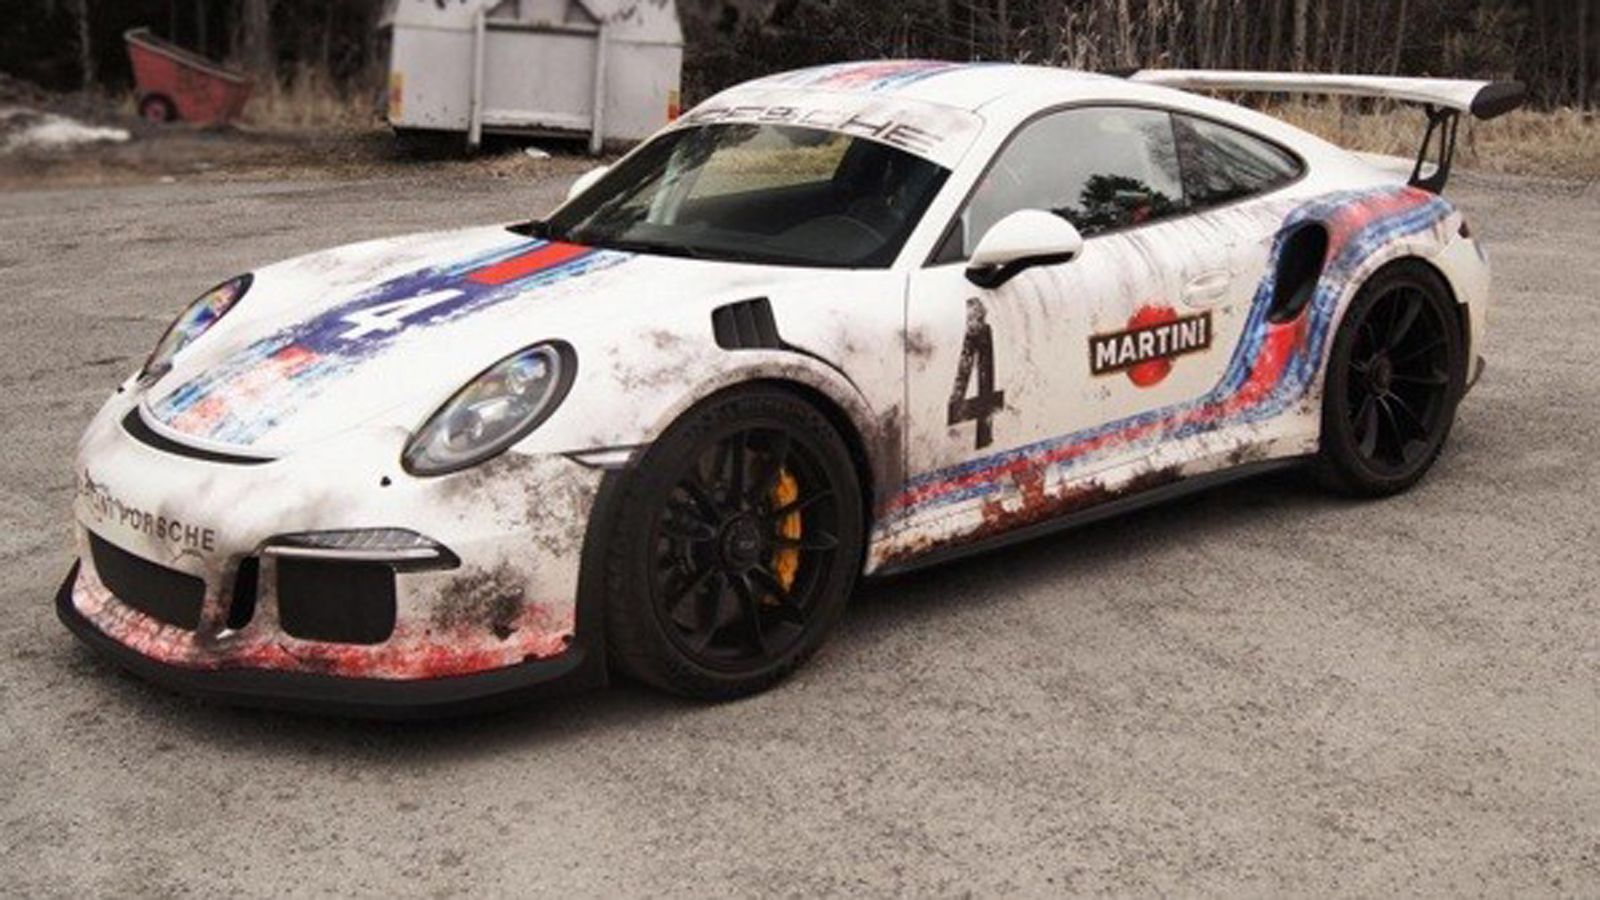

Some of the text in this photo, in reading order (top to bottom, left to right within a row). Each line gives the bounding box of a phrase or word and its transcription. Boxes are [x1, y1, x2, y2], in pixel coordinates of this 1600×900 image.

[338, 288, 466, 340] 4
[1095, 318, 1206, 369] MARTINI
[947, 297, 1004, 450] 4
